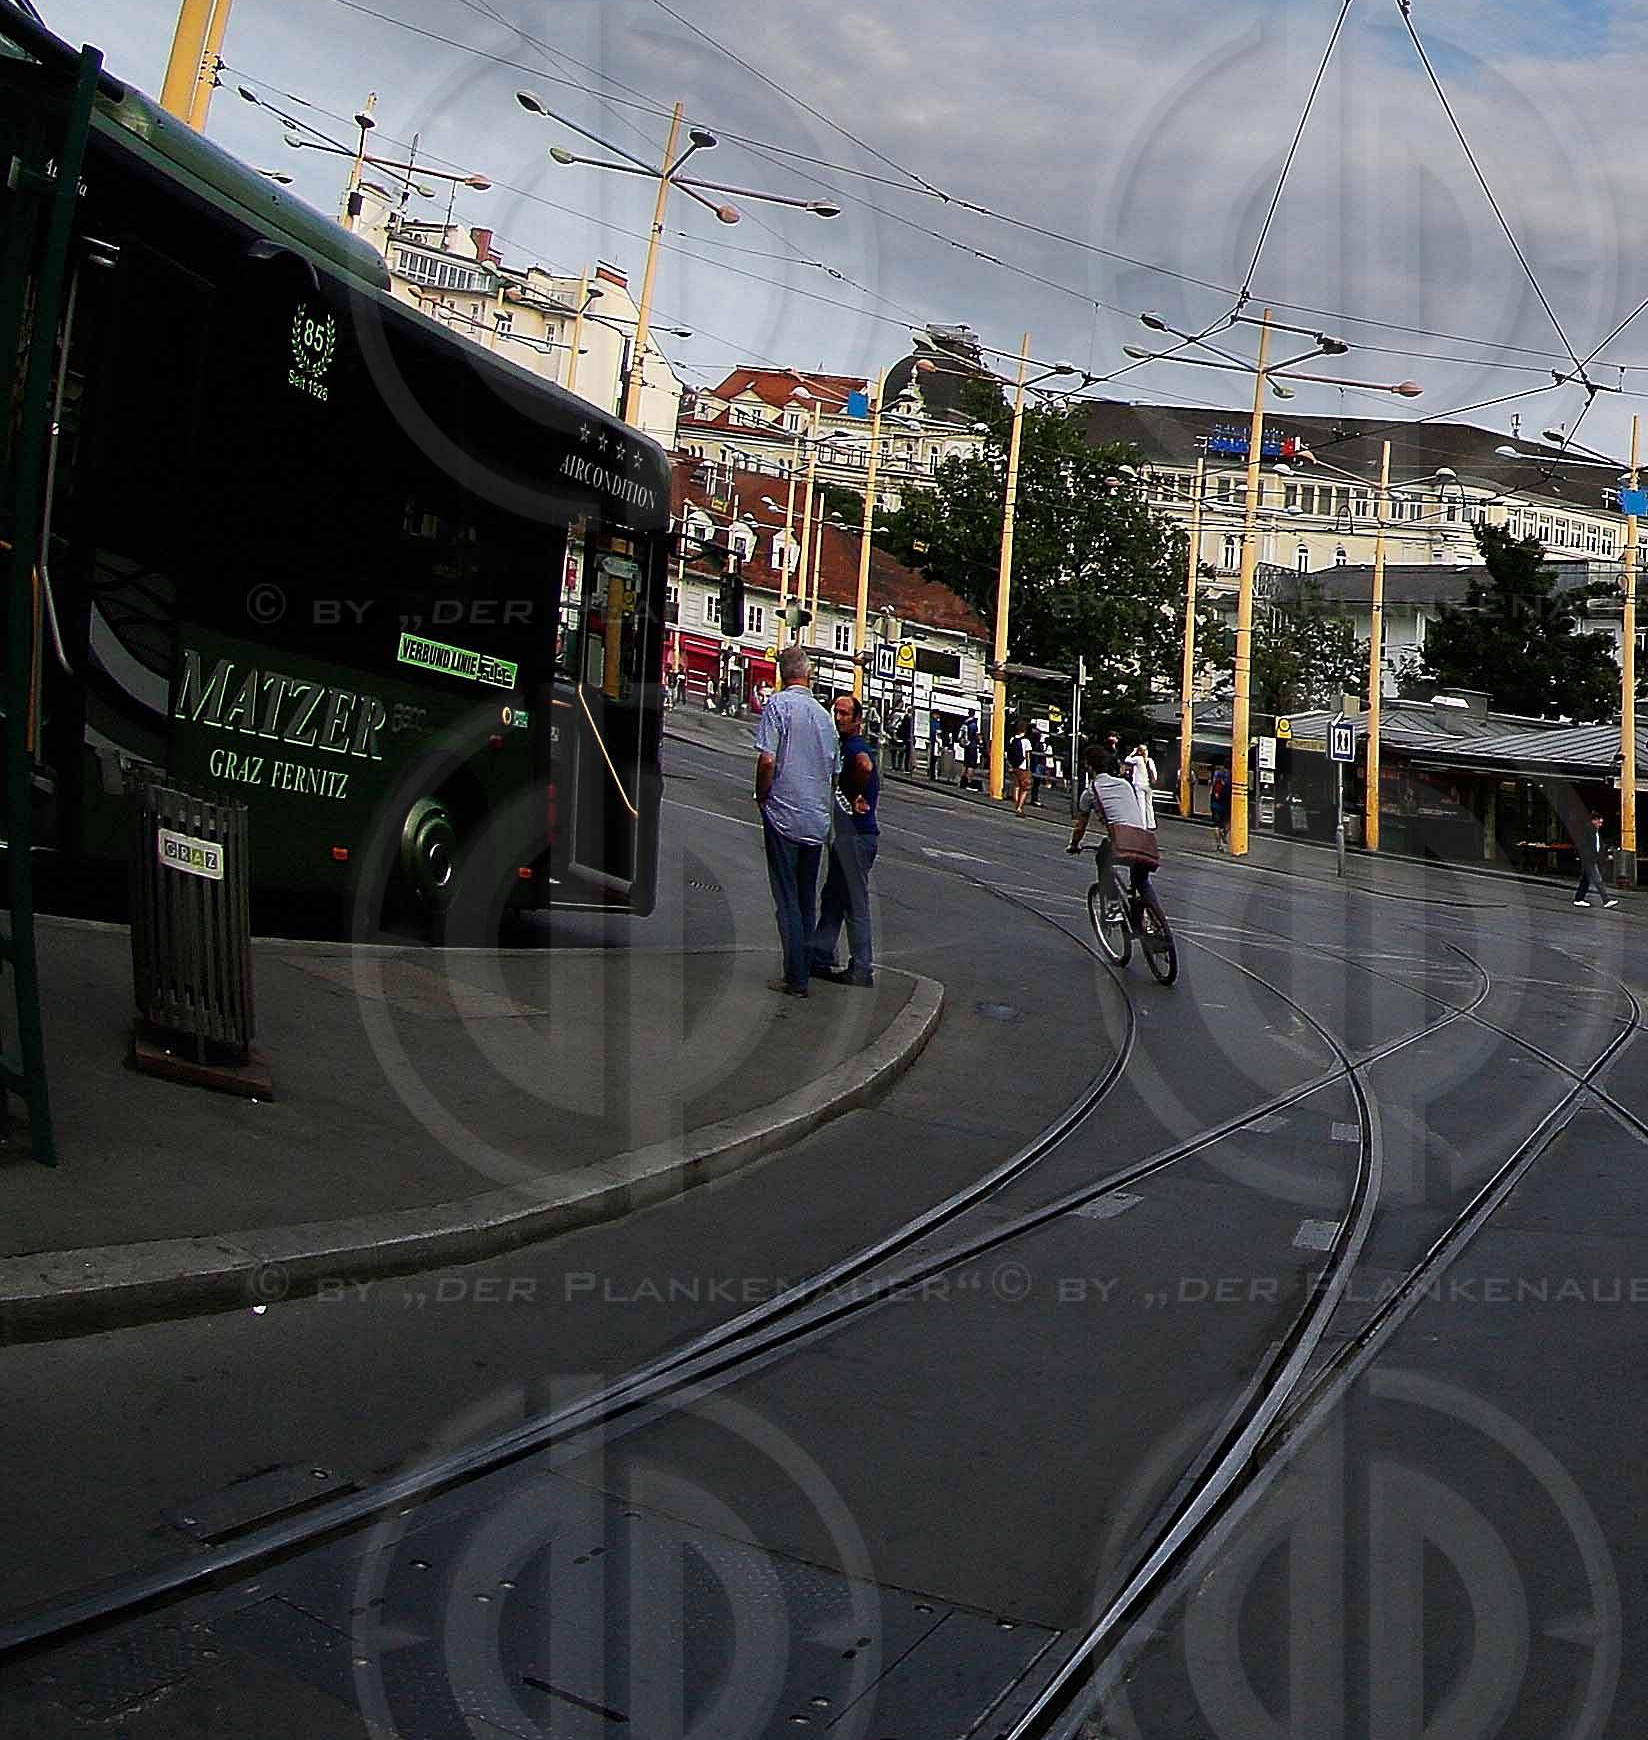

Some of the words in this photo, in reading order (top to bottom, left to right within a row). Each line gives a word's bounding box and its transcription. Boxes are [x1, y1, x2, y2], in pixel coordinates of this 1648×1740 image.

[303, 318, 325, 352] 85
[560, 453, 657, 509] AIRCONDITION
[402, 638, 451, 671] VERBUND
[451, 651, 478, 677] LINIE
[175, 647, 387, 761] MATZER
[209, 748, 265, 785] GRAZ
[270, 761, 350, 800] FERNITZ
[164, 840, 219, 871] GRAZ
